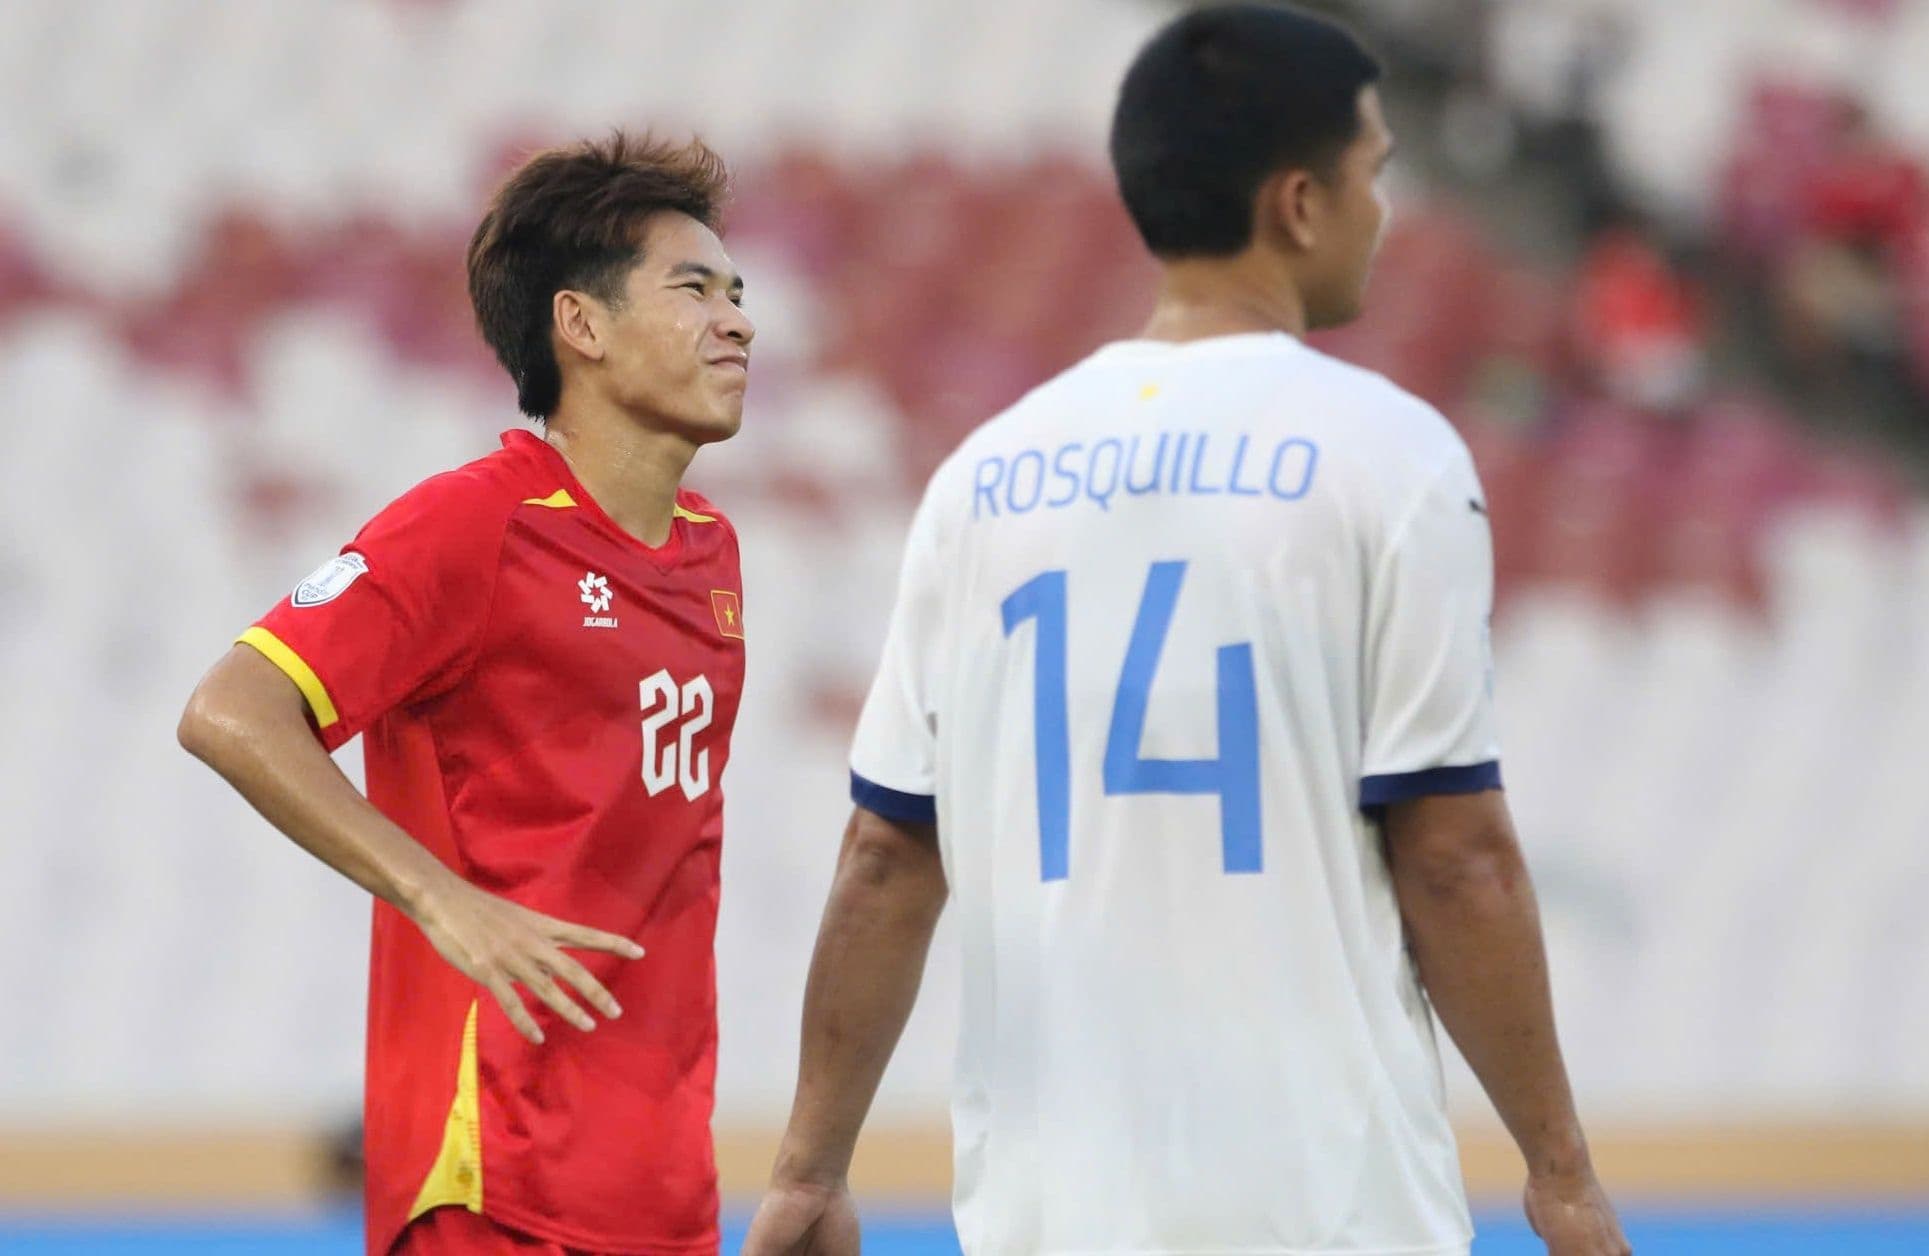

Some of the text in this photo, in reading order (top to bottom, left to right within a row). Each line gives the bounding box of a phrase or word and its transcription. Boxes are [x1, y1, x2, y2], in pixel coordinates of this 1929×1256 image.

[973, 431, 1319, 521] ROSQUILLO
[639, 668, 714, 802] 22
[1000, 560, 1263, 882] 14
